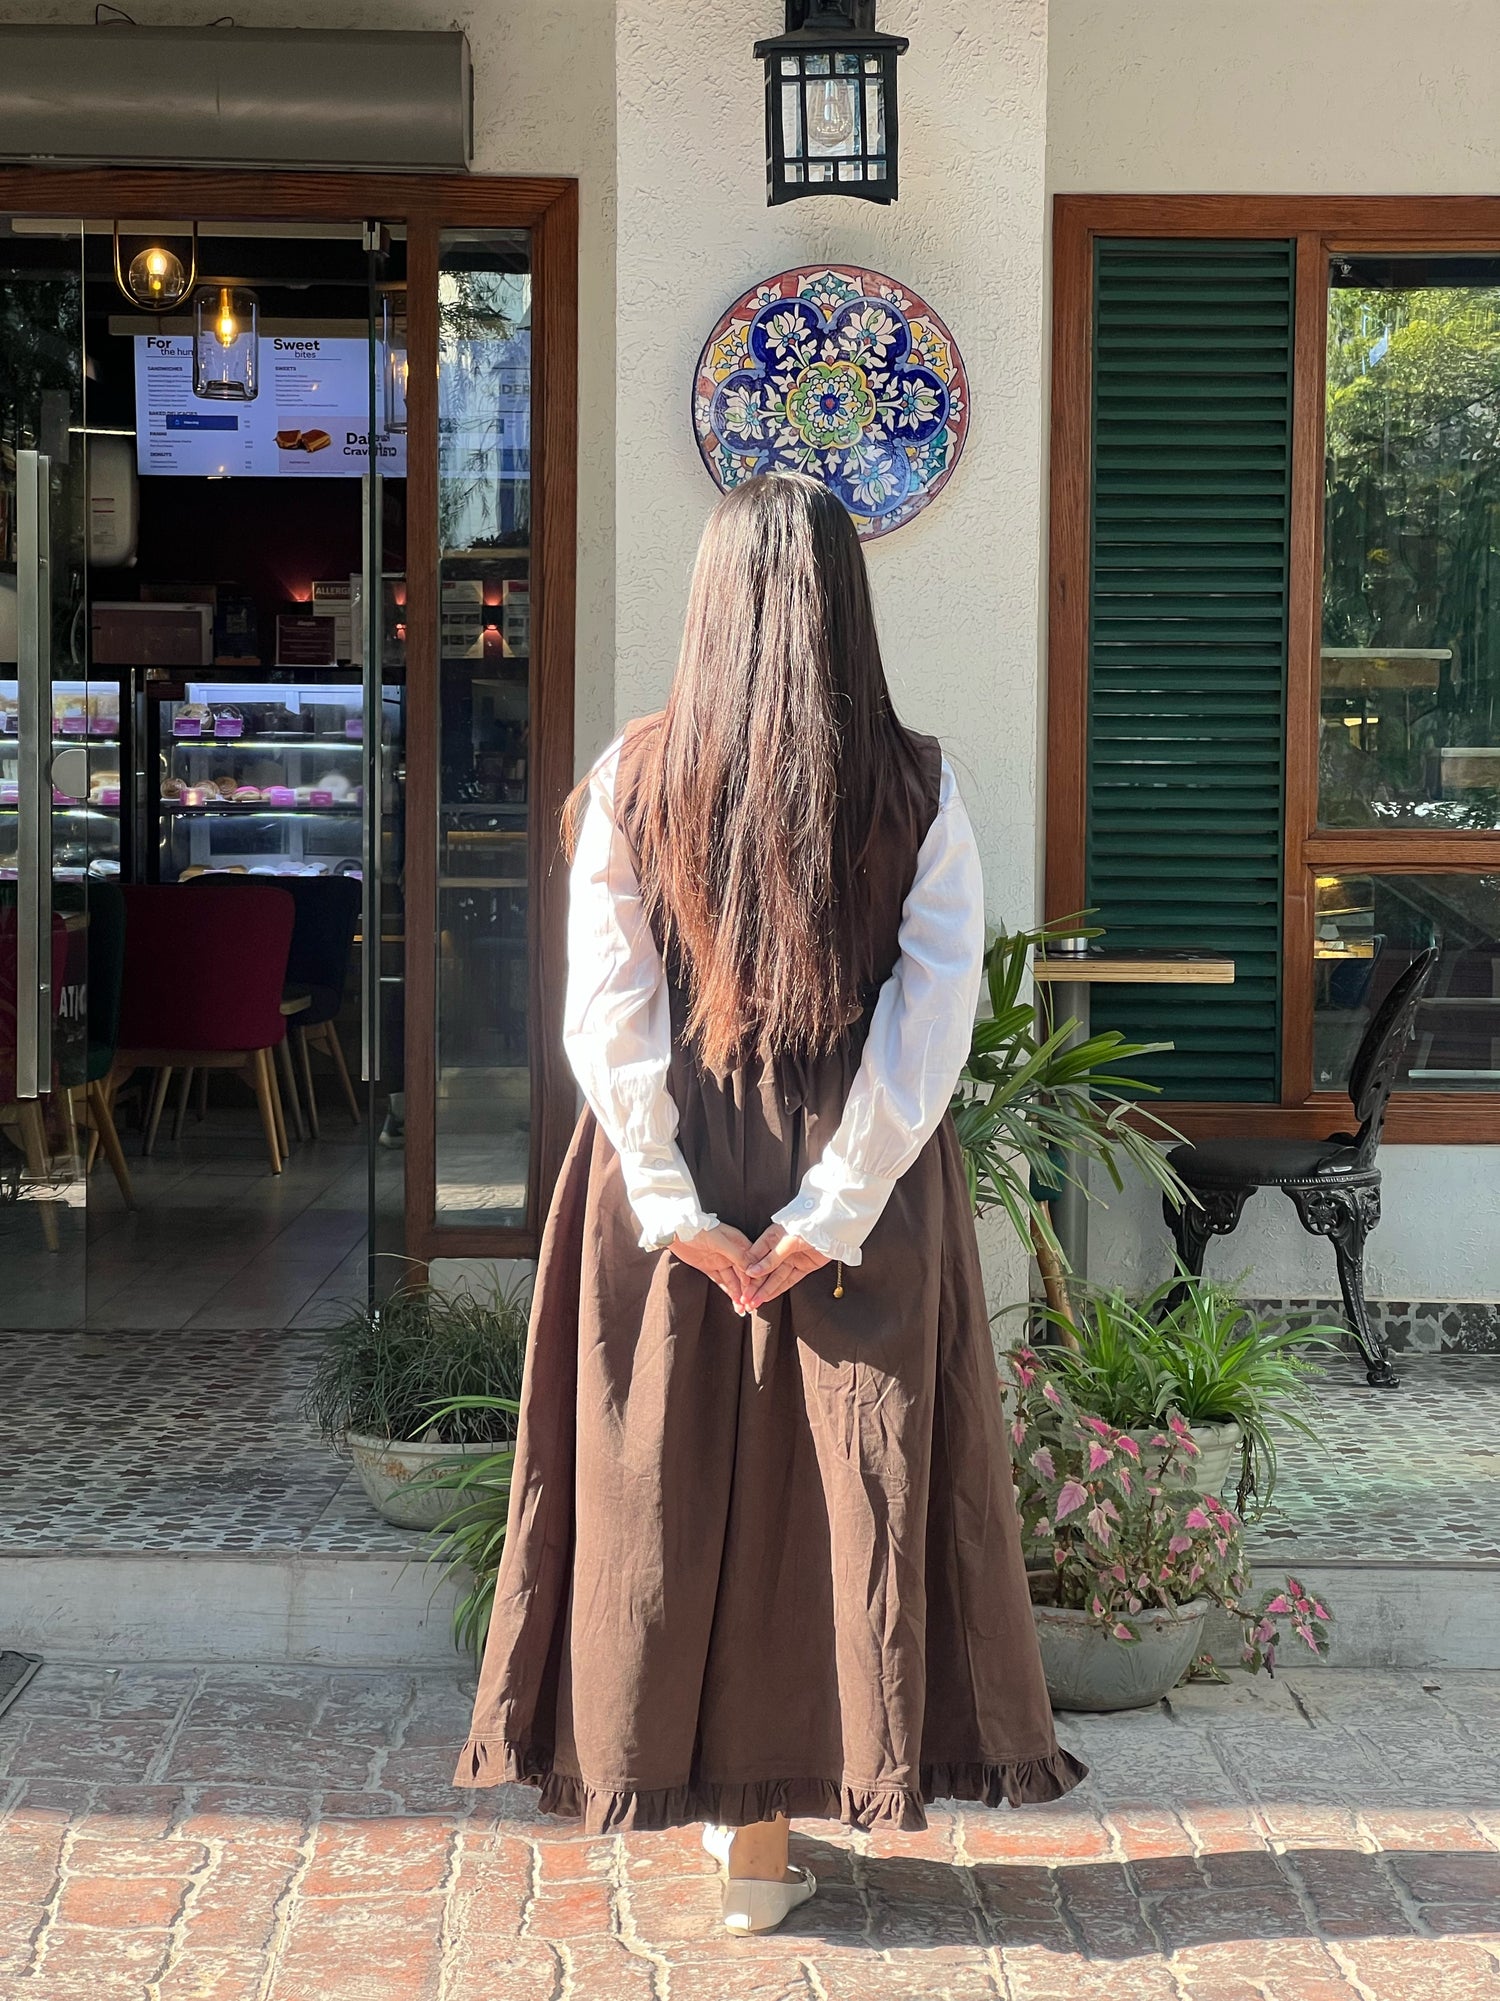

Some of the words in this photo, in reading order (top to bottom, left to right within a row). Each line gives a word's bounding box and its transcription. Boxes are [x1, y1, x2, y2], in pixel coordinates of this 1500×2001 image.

[147, 337, 172, 349] For
[273, 338, 321, 351] Sweet
[160, 347, 175, 356] the
[294, 350, 317, 359] bites
